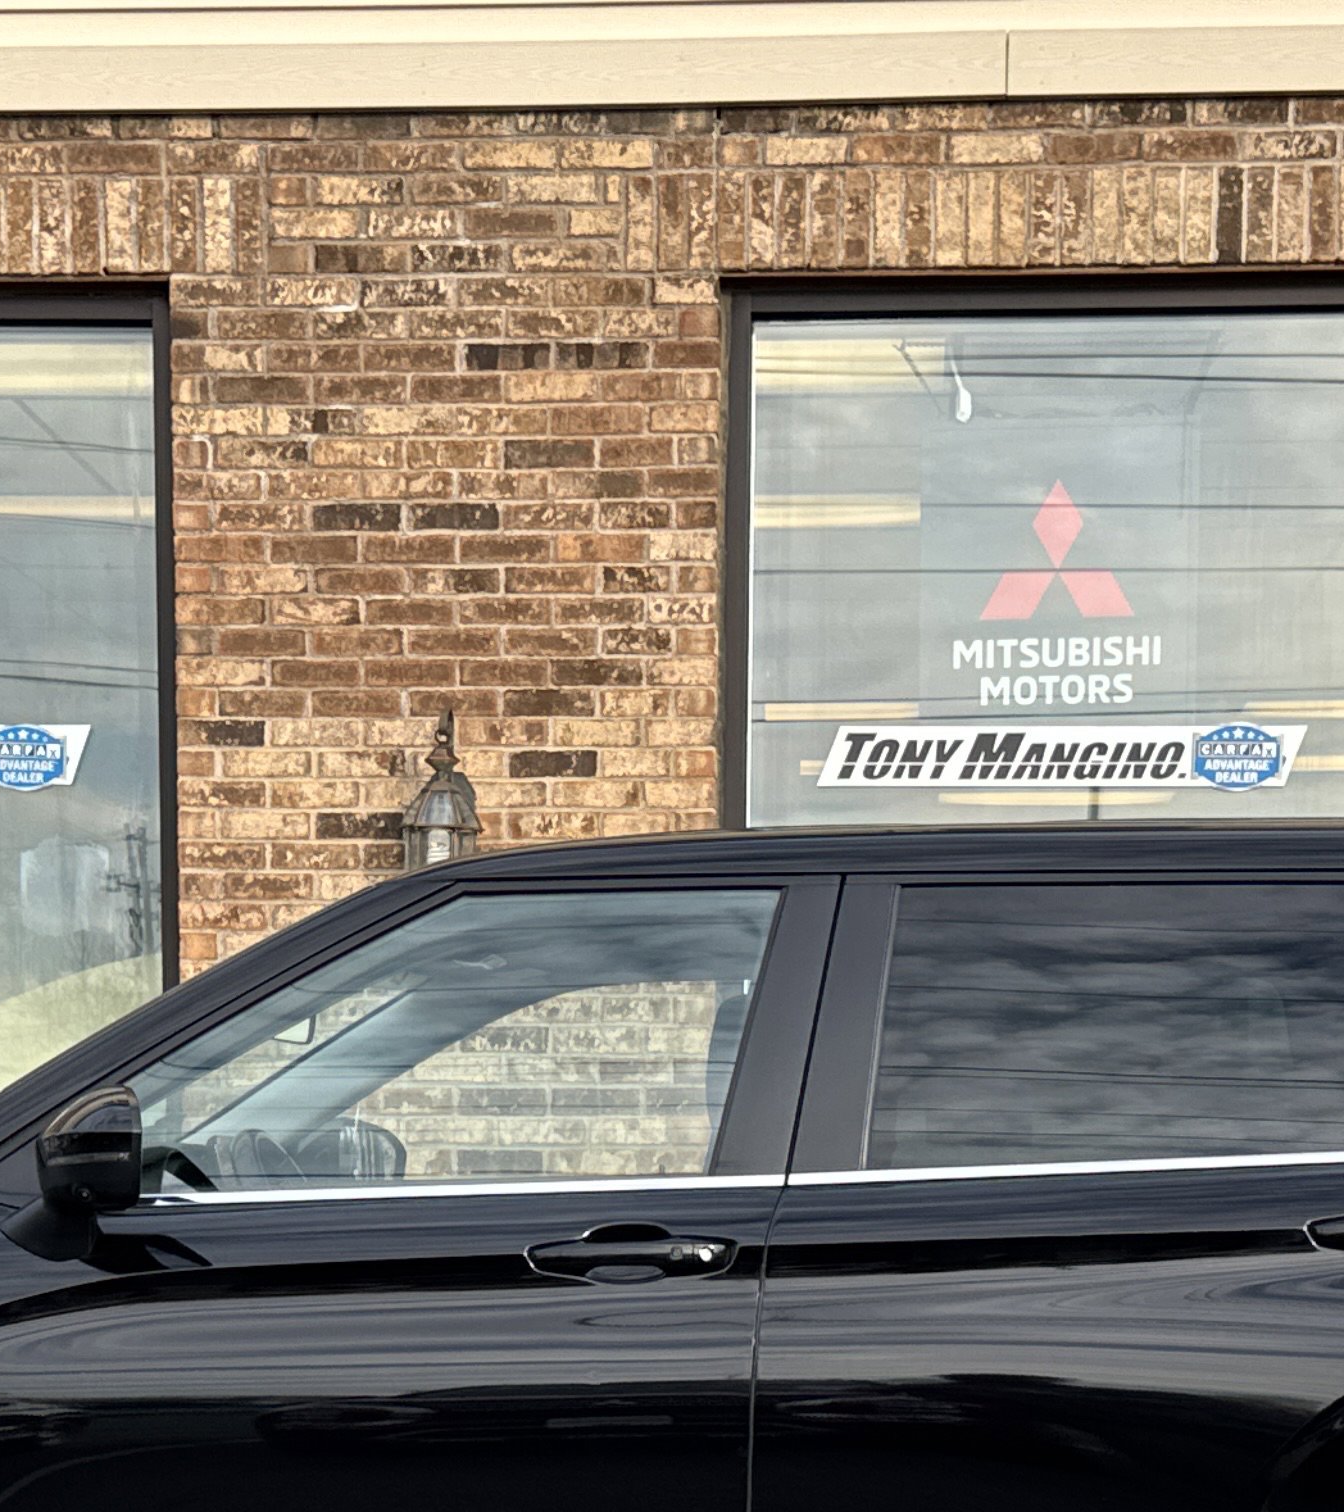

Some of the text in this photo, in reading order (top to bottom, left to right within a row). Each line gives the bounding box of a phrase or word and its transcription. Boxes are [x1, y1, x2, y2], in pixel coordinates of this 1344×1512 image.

[952, 635, 1162, 670] MITSUBISHI
[979, 673, 1134, 706] MOTORS
[837, 732, 965, 780] TONY
[1200, 743, 1276, 758] CARFAX
[1204, 758, 1271, 771] ADVANTAGE
[1, 771, 45, 783] DEALER
[1214, 771, 1259, 783] DEALER
